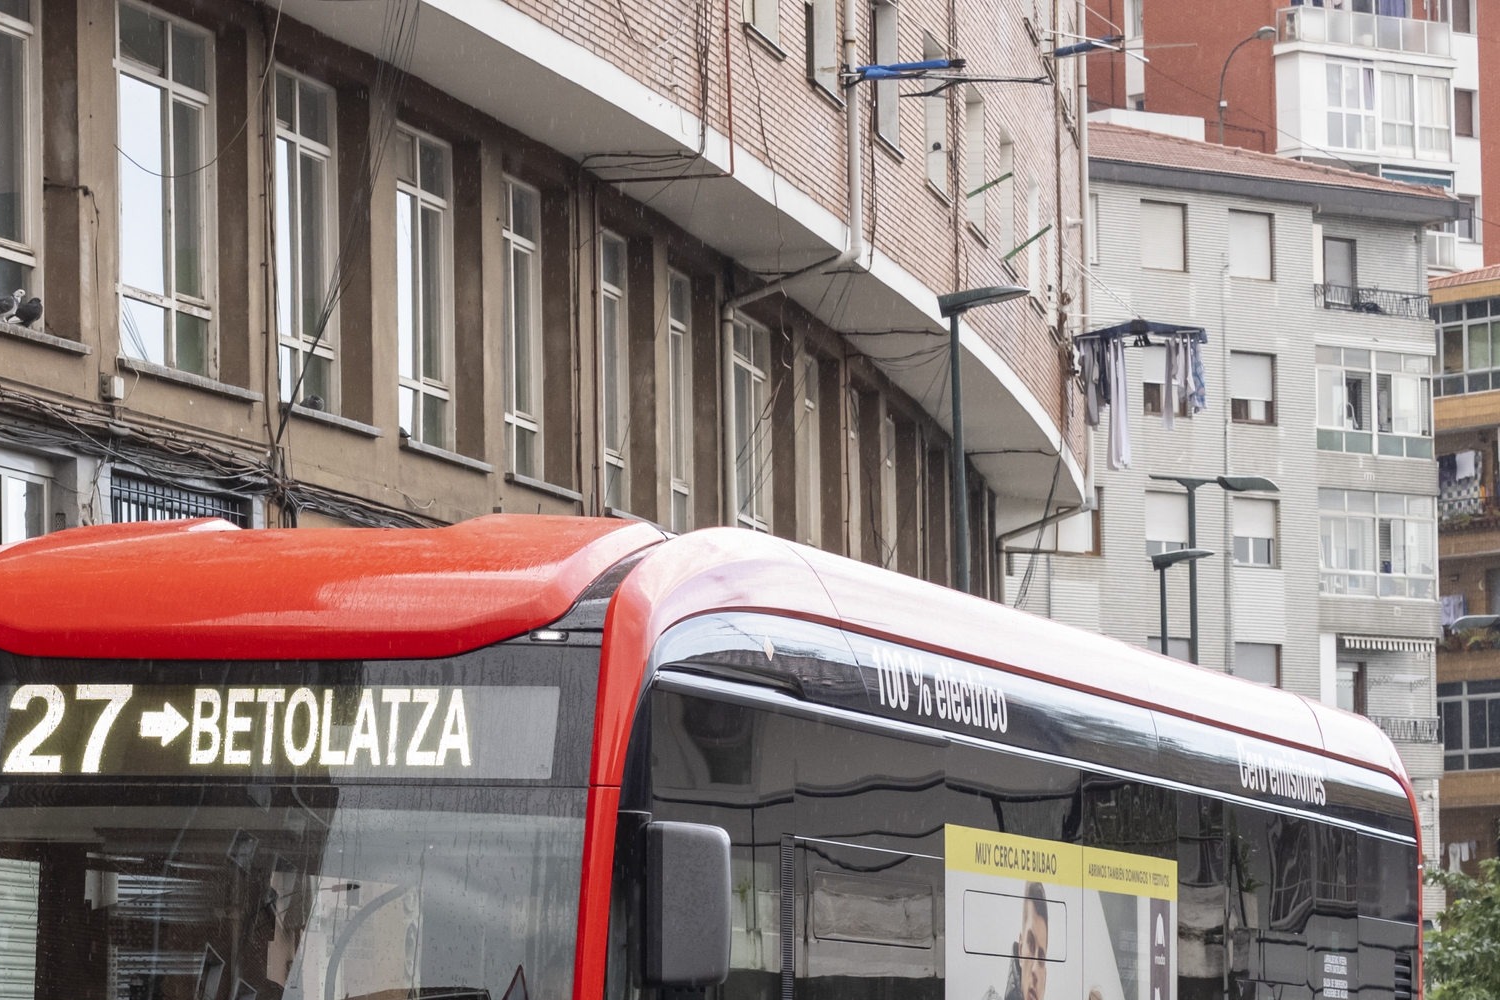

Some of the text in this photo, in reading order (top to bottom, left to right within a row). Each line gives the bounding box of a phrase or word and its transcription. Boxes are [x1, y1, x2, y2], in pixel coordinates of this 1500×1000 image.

[872, 645, 909, 711] 100
[2, 684, 472, 774] 27 BETOLATZA
[975, 842, 1057, 875] MUY CERCA DE BILBAO
[1088, 863, 1107, 879] ABRIMOS
[1125, 868, 1148, 884] DOMINGOS
[1155, 954, 1166, 965] moda
